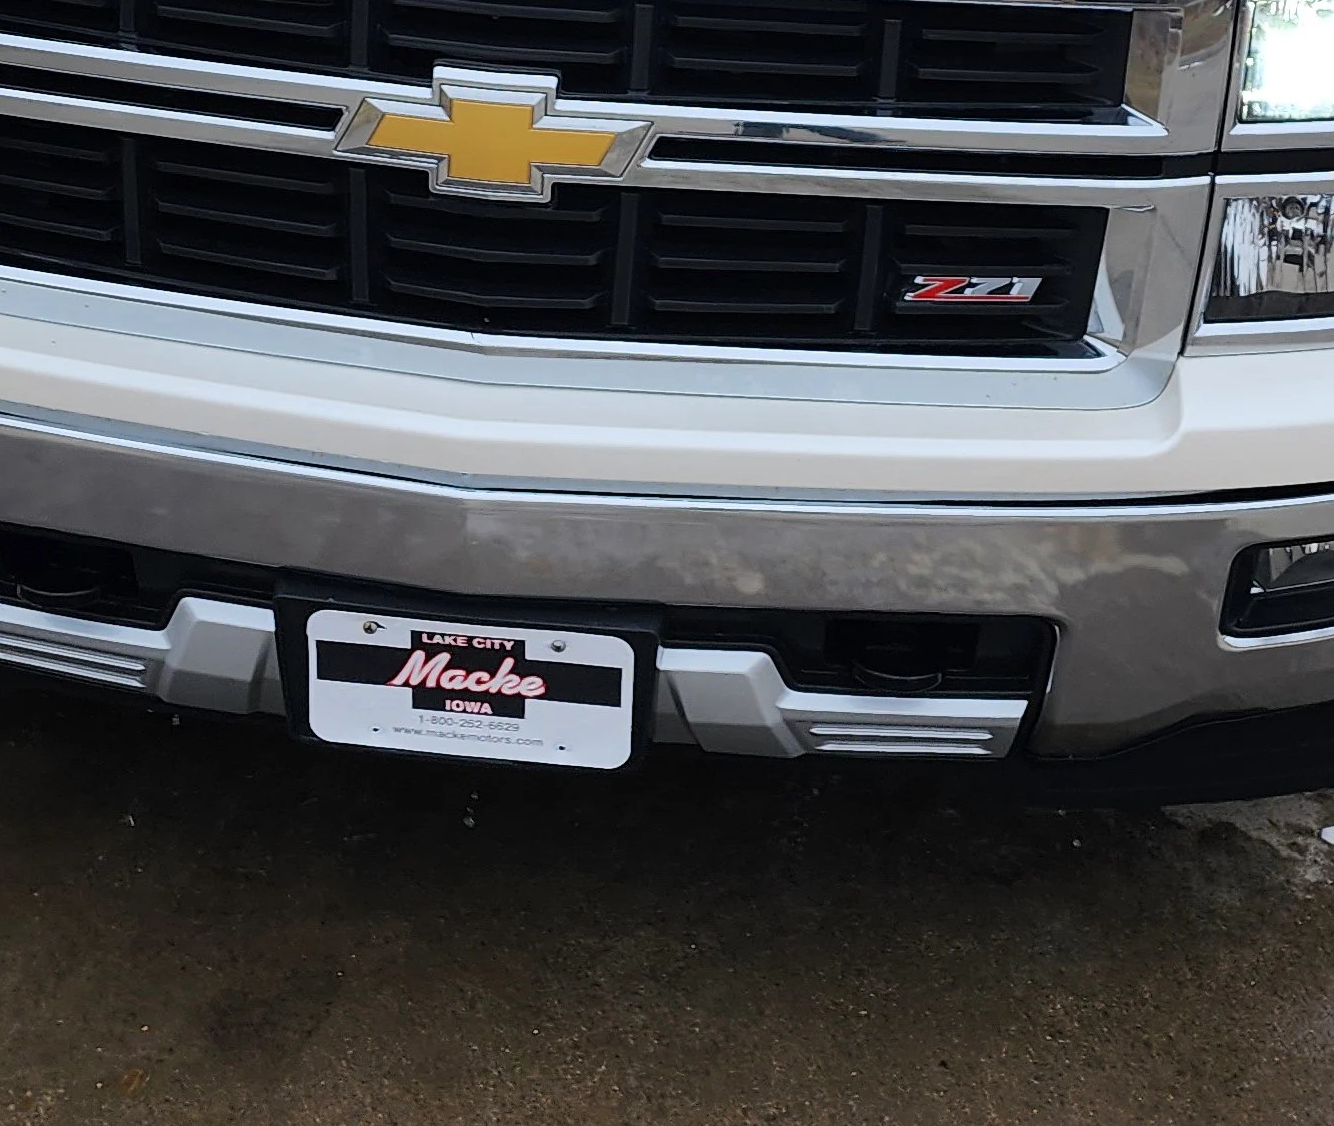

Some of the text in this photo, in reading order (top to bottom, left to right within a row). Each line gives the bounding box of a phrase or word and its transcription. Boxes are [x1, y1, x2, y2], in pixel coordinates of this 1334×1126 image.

[904, 276, 1043, 302] Z71
[422, 633, 515, 650] LAKE CITY
[386, 649, 546, 698] Macke
[444, 699, 493, 714] IOWA
[393, 727, 544, 747] www.mackemotors.com
